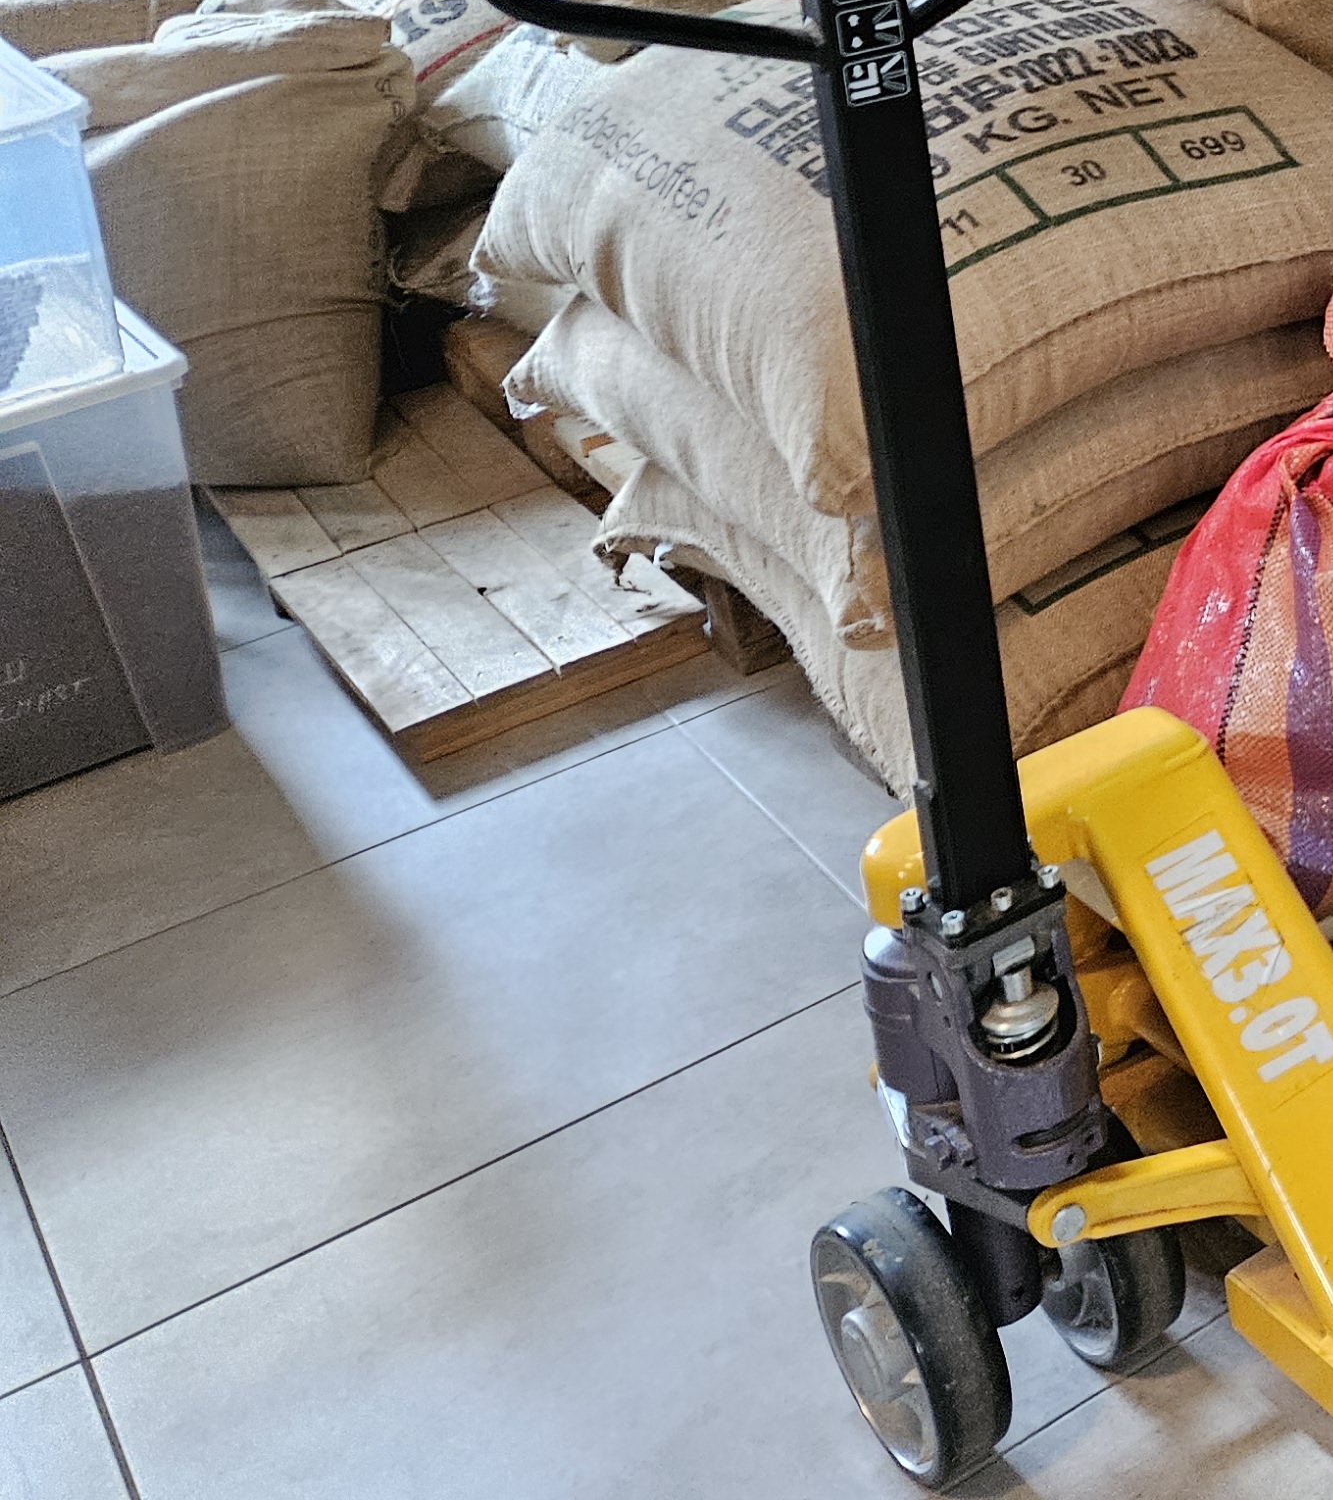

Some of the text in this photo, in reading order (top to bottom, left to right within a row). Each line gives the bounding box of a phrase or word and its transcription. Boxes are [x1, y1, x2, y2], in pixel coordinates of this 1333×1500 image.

[964, 106, 1073, 154] KG.
[1076, 72, 1186, 114] NET
[1061, 160, 1106, 186] 30
[1179, 130, 1246, 162] 699
